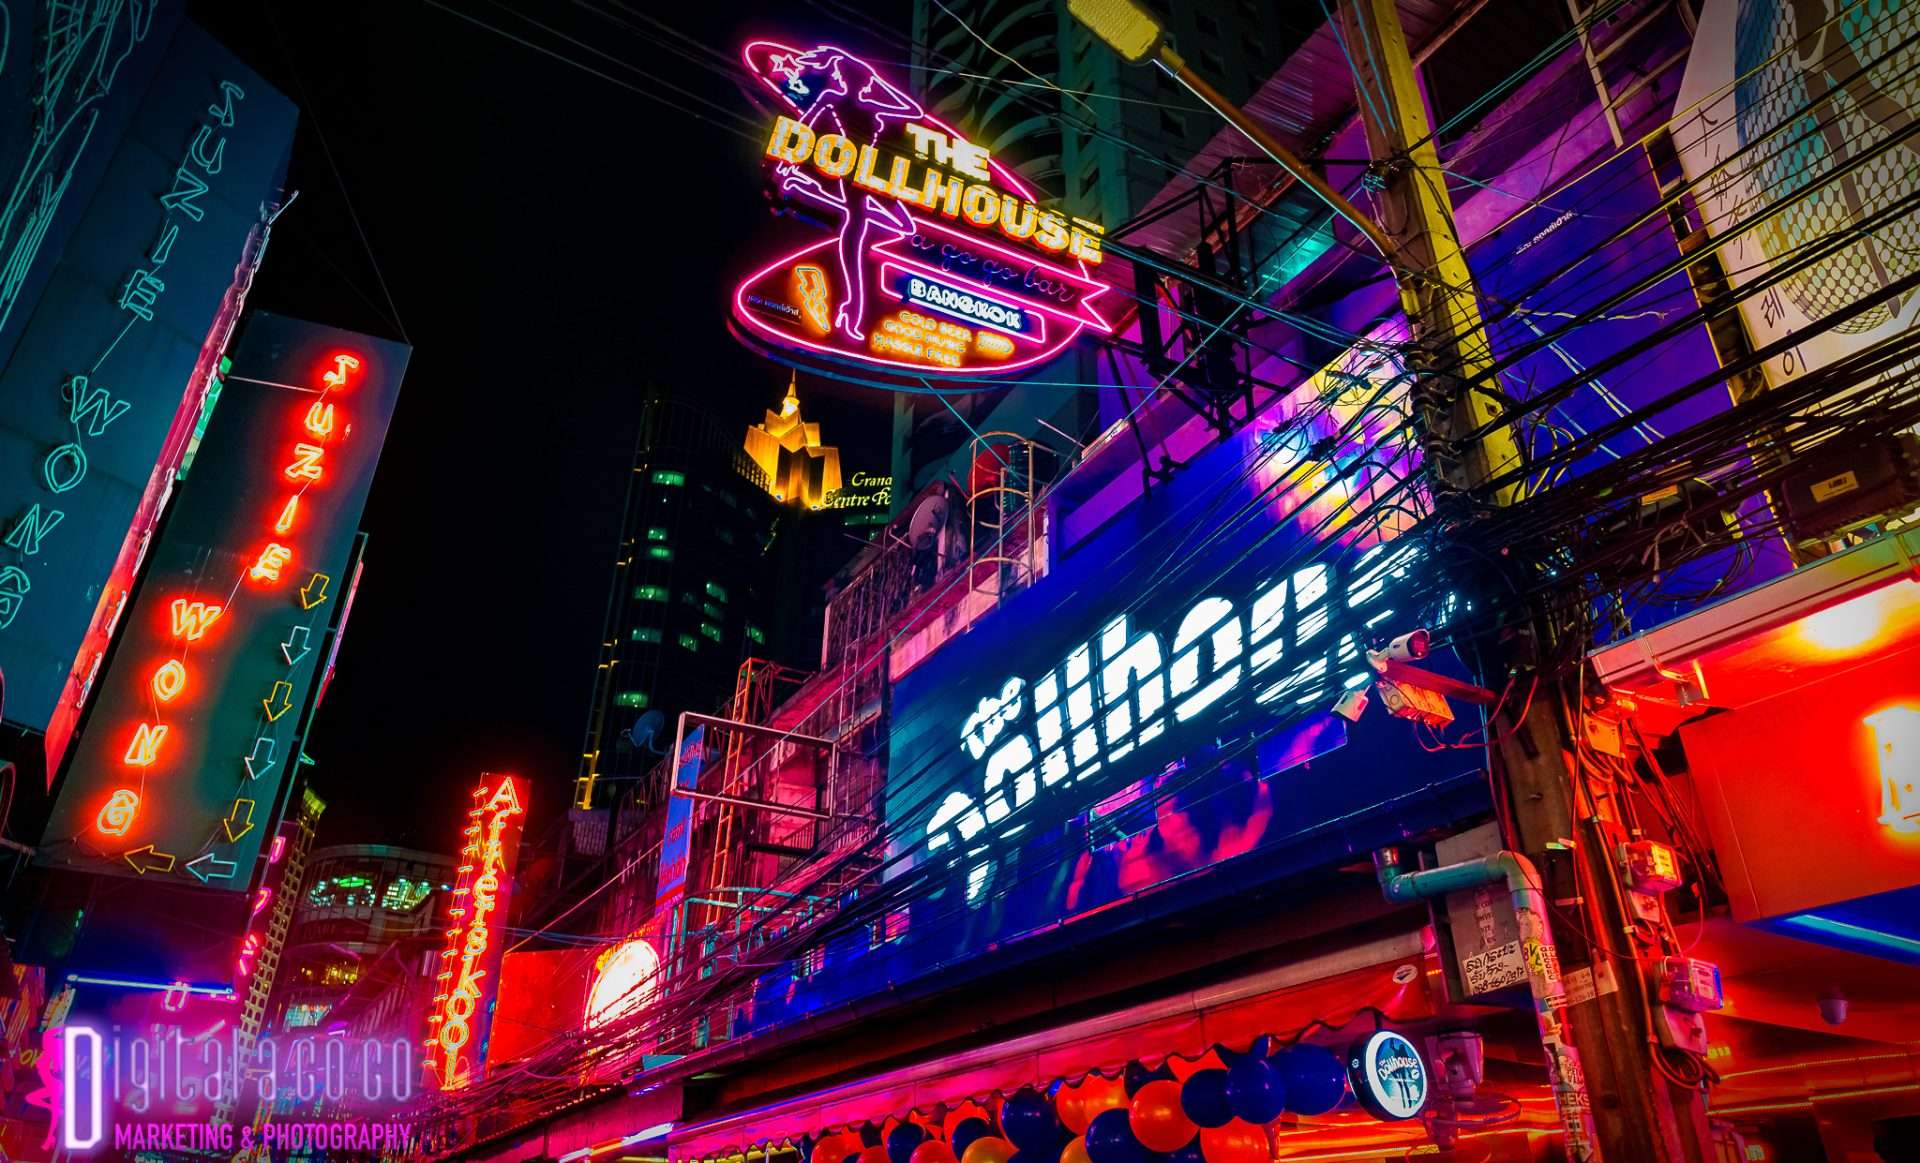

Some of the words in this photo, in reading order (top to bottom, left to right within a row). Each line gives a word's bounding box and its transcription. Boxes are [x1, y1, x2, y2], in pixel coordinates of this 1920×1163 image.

[906, 122, 990, 182] THE
[118, 80, 245, 321] SUZIE
[766, 115, 1105, 264] DOLLHOUSE
[911, 234, 935, 250] a
[941, 244, 977, 272] go
[982, 260, 1019, 288] go
[1024, 264, 1074, 302] bar
[883, 320, 923, 340] GOOD
[899, 311, 938, 331] COLD
[909, 278, 1022, 329] BANGKOK
[927, 347, 961, 367] FREE
[249, 355, 360, 581] SUZIE
[97, 599, 224, 836] WONG
[1378, 1056, 1418, 1081] Dollhouse
